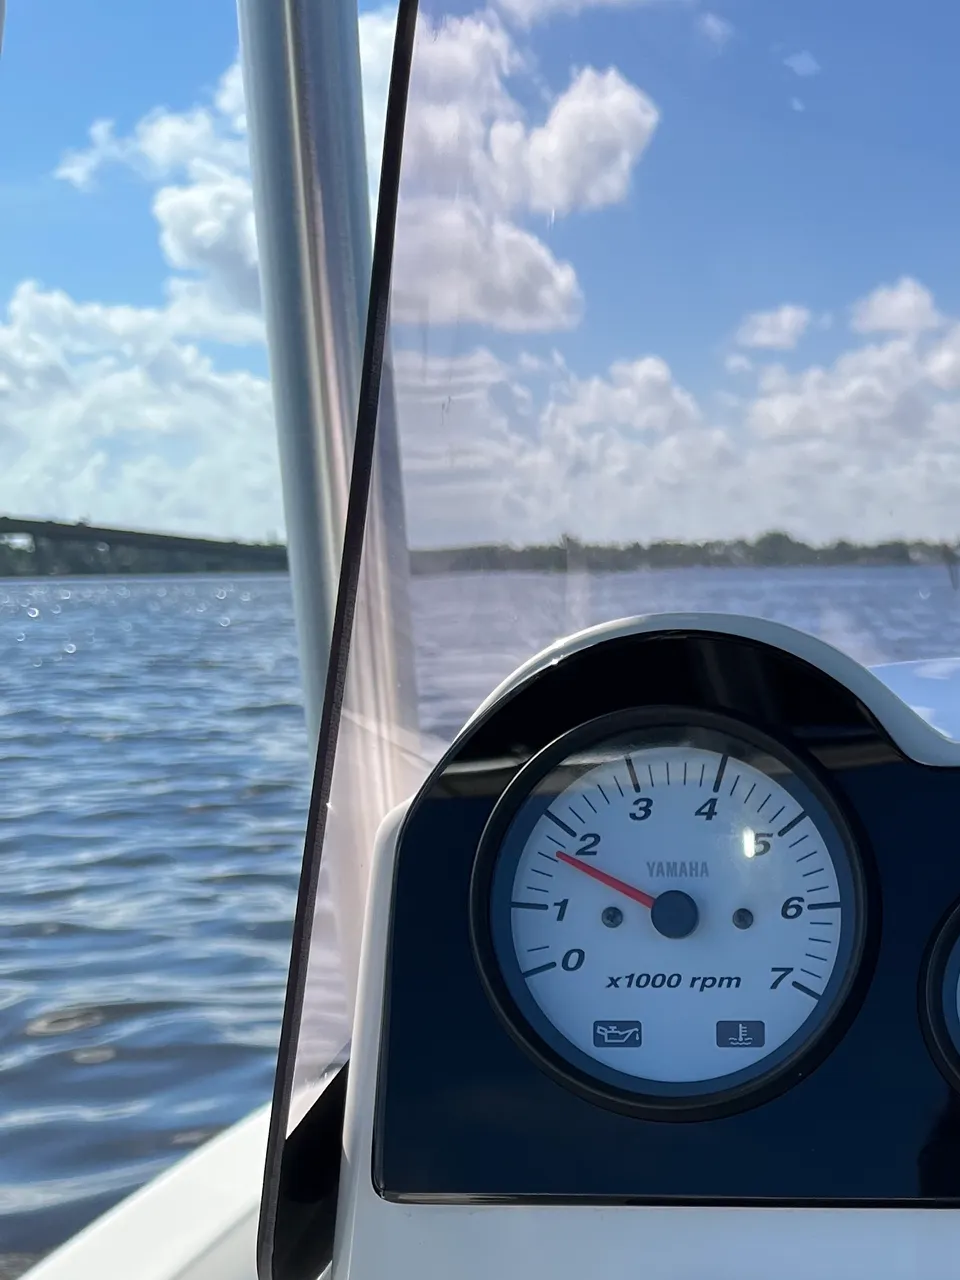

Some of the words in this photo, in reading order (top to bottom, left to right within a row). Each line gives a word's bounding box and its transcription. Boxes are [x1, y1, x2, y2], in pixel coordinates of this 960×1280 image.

[629, 798, 653, 821] 3
[695, 798, 717, 821] 4
[575, 833, 601, 856] 2
[752, 832, 773, 856] 5
[646, 861, 709, 878] YAMAHA
[552, 899, 568, 921] 1
[780, 896, 804, 920] 6
[561, 948, 585, 971] 0
[606, 973, 682, 989] x1000
[689, 975, 742, 991] rpm
[769, 968, 793, 990] 7
